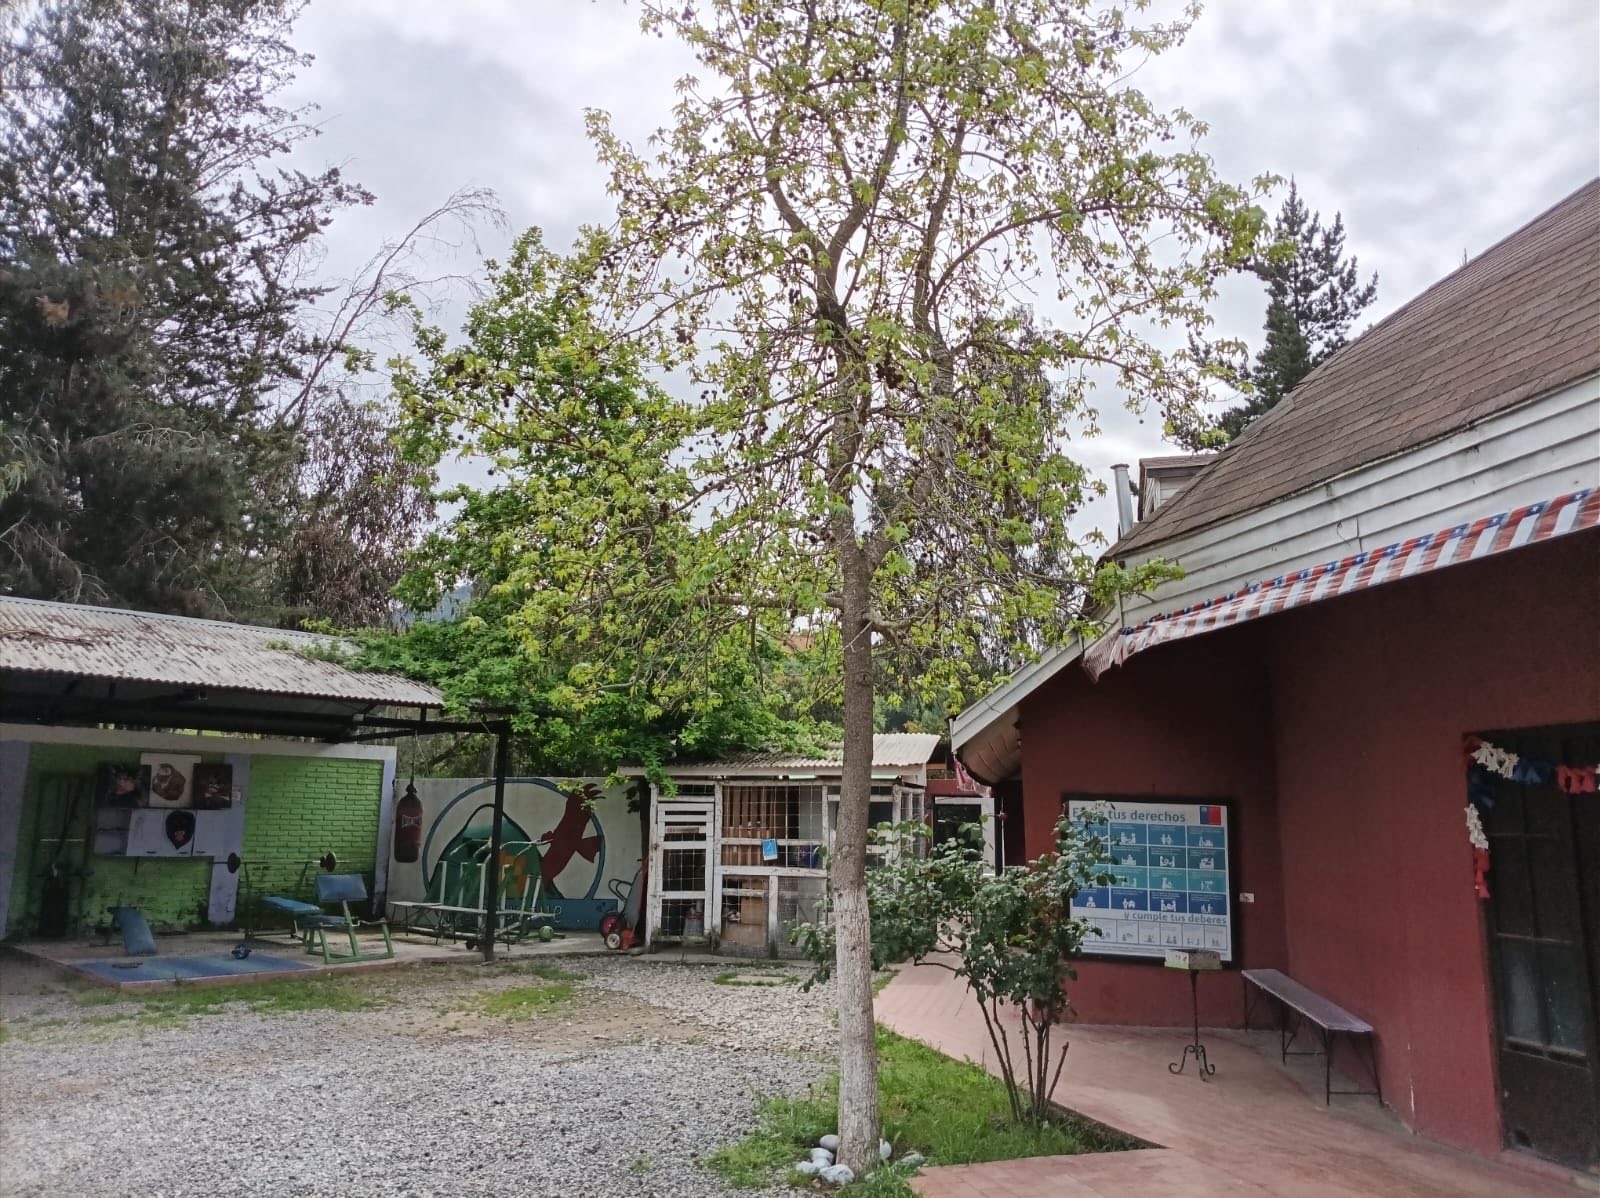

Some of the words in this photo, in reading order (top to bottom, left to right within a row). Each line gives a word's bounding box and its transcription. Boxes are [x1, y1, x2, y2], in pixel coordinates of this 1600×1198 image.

[1108, 809, 1126, 820] tus
[1130, 810, 1186, 822] derechos
[1132, 912, 1168, 921] cumple
[1170, 914, 1186, 922] tus
[1188, 914, 1227, 924] deberes
